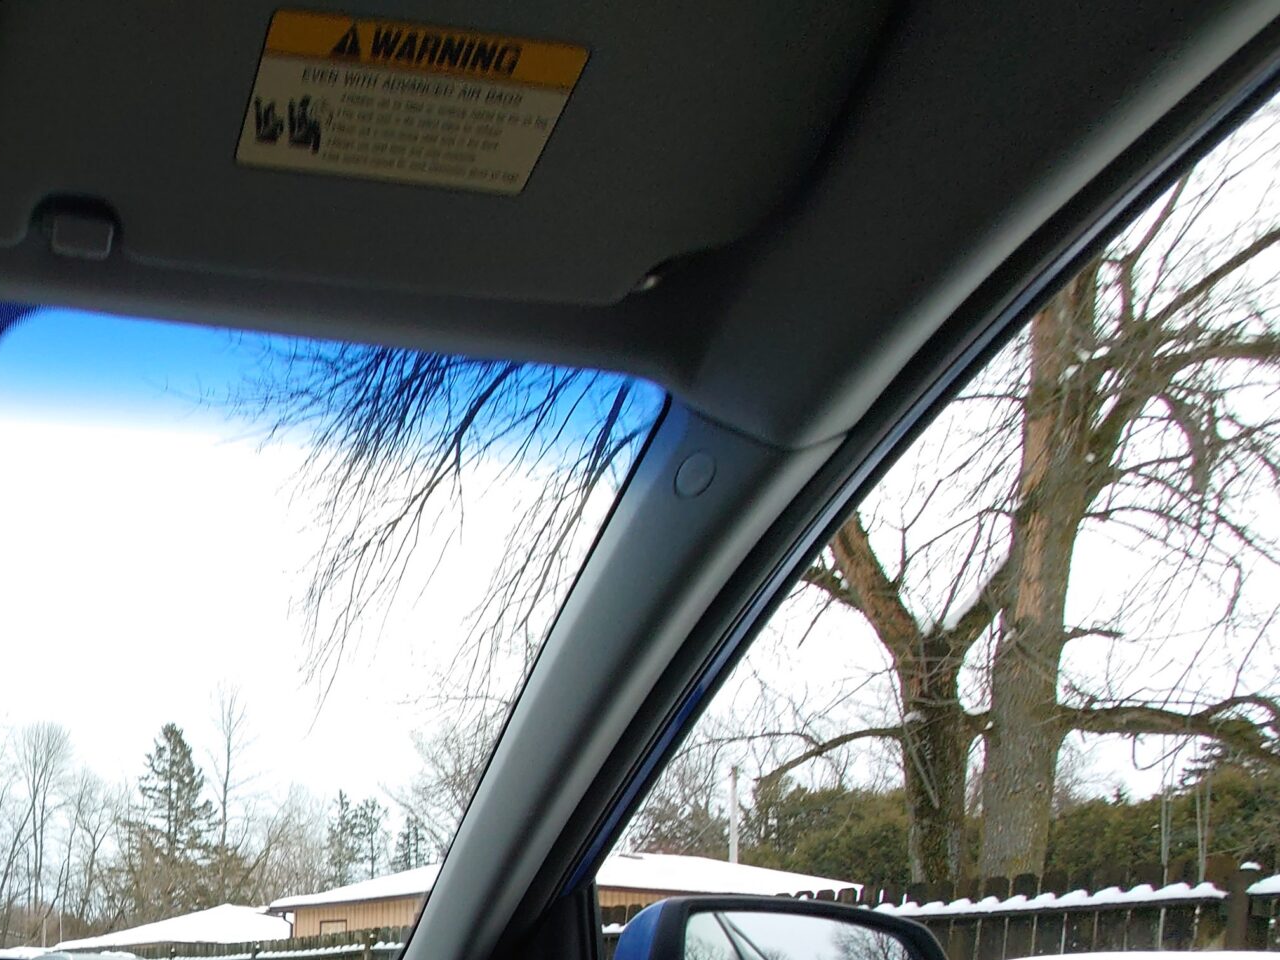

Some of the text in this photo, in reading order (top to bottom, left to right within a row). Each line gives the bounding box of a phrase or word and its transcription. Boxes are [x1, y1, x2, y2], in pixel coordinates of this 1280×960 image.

[370, 26, 523, 76] WARNING
[301, 66, 339, 84] EVEN
[343, 70, 378, 89] WITH
